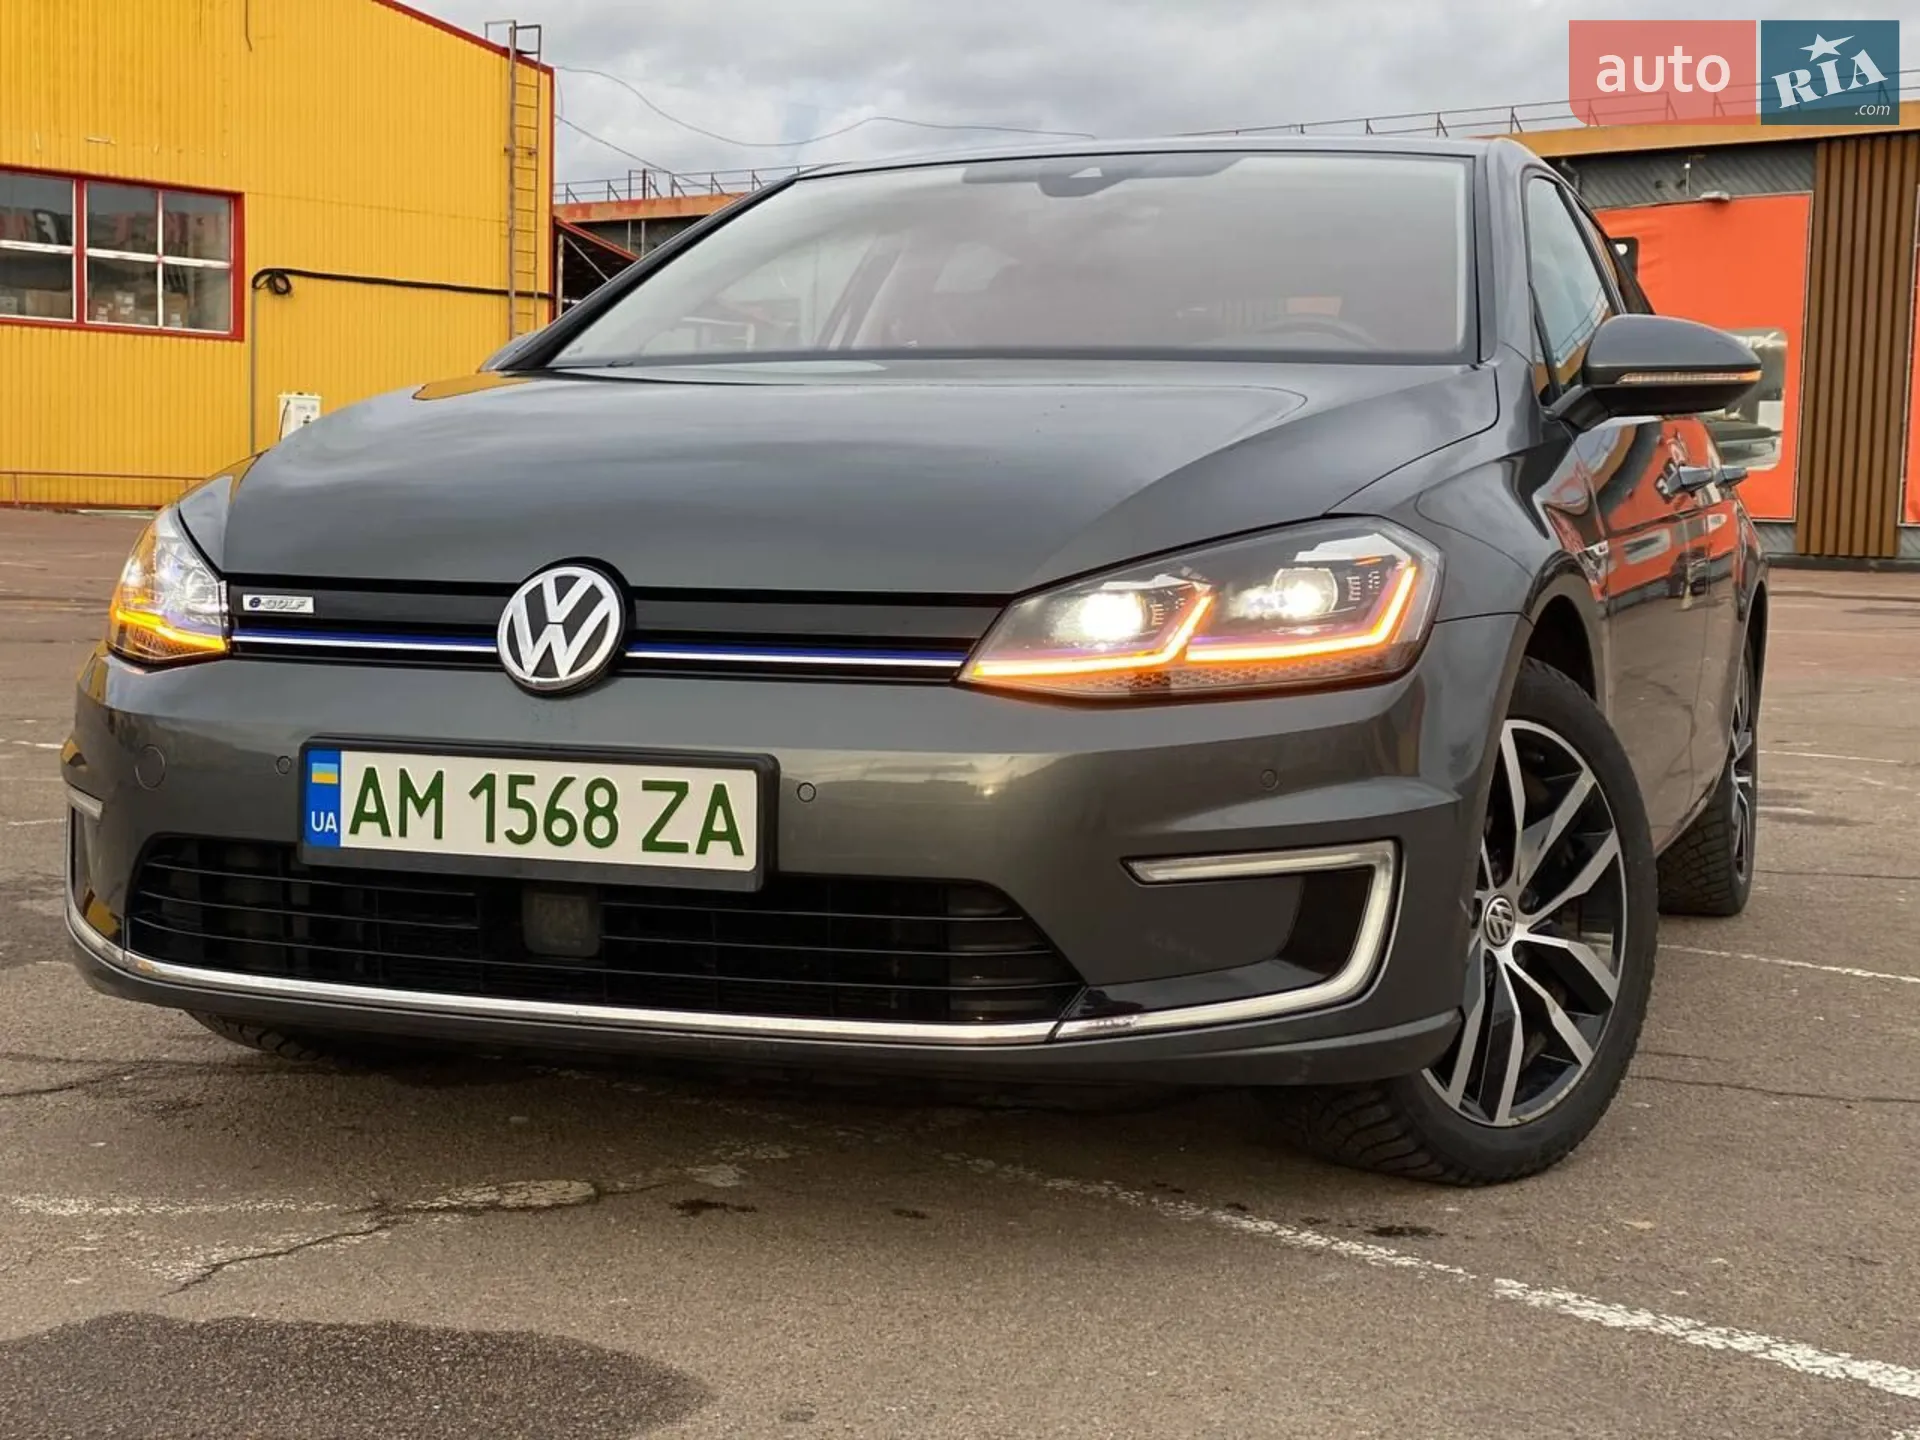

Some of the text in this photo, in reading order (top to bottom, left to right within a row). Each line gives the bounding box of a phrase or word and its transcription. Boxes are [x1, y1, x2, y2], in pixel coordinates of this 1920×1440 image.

[311, 811, 338, 834] UA
[348, 766, 745, 857] AM 1568 ZA
